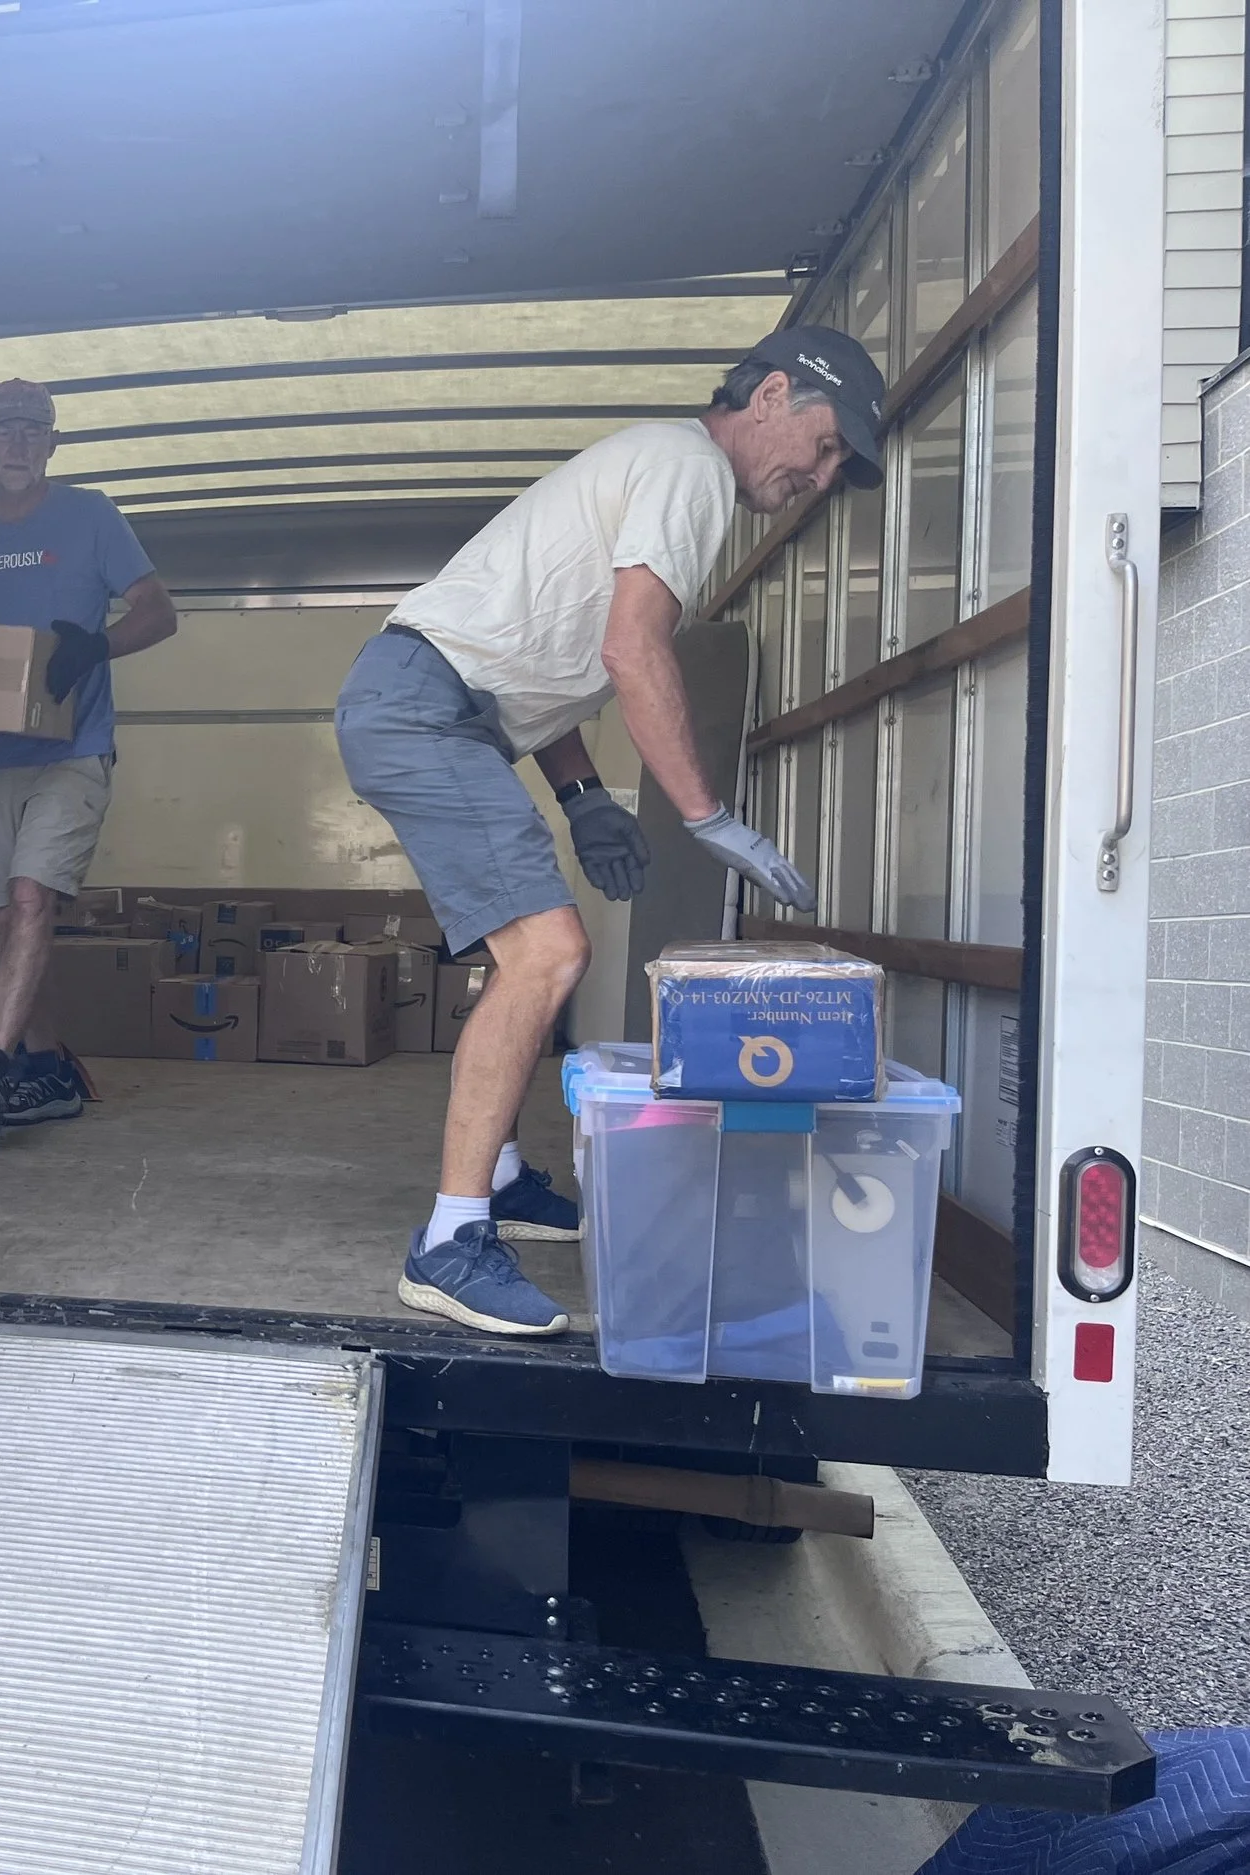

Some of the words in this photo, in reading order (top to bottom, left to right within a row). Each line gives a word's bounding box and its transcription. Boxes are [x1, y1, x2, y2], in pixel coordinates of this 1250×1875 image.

[796, 353, 843, 387] Technologies
[746, 1010, 813, 1025] Number:
[817, 1010, 853, 1024] Item
